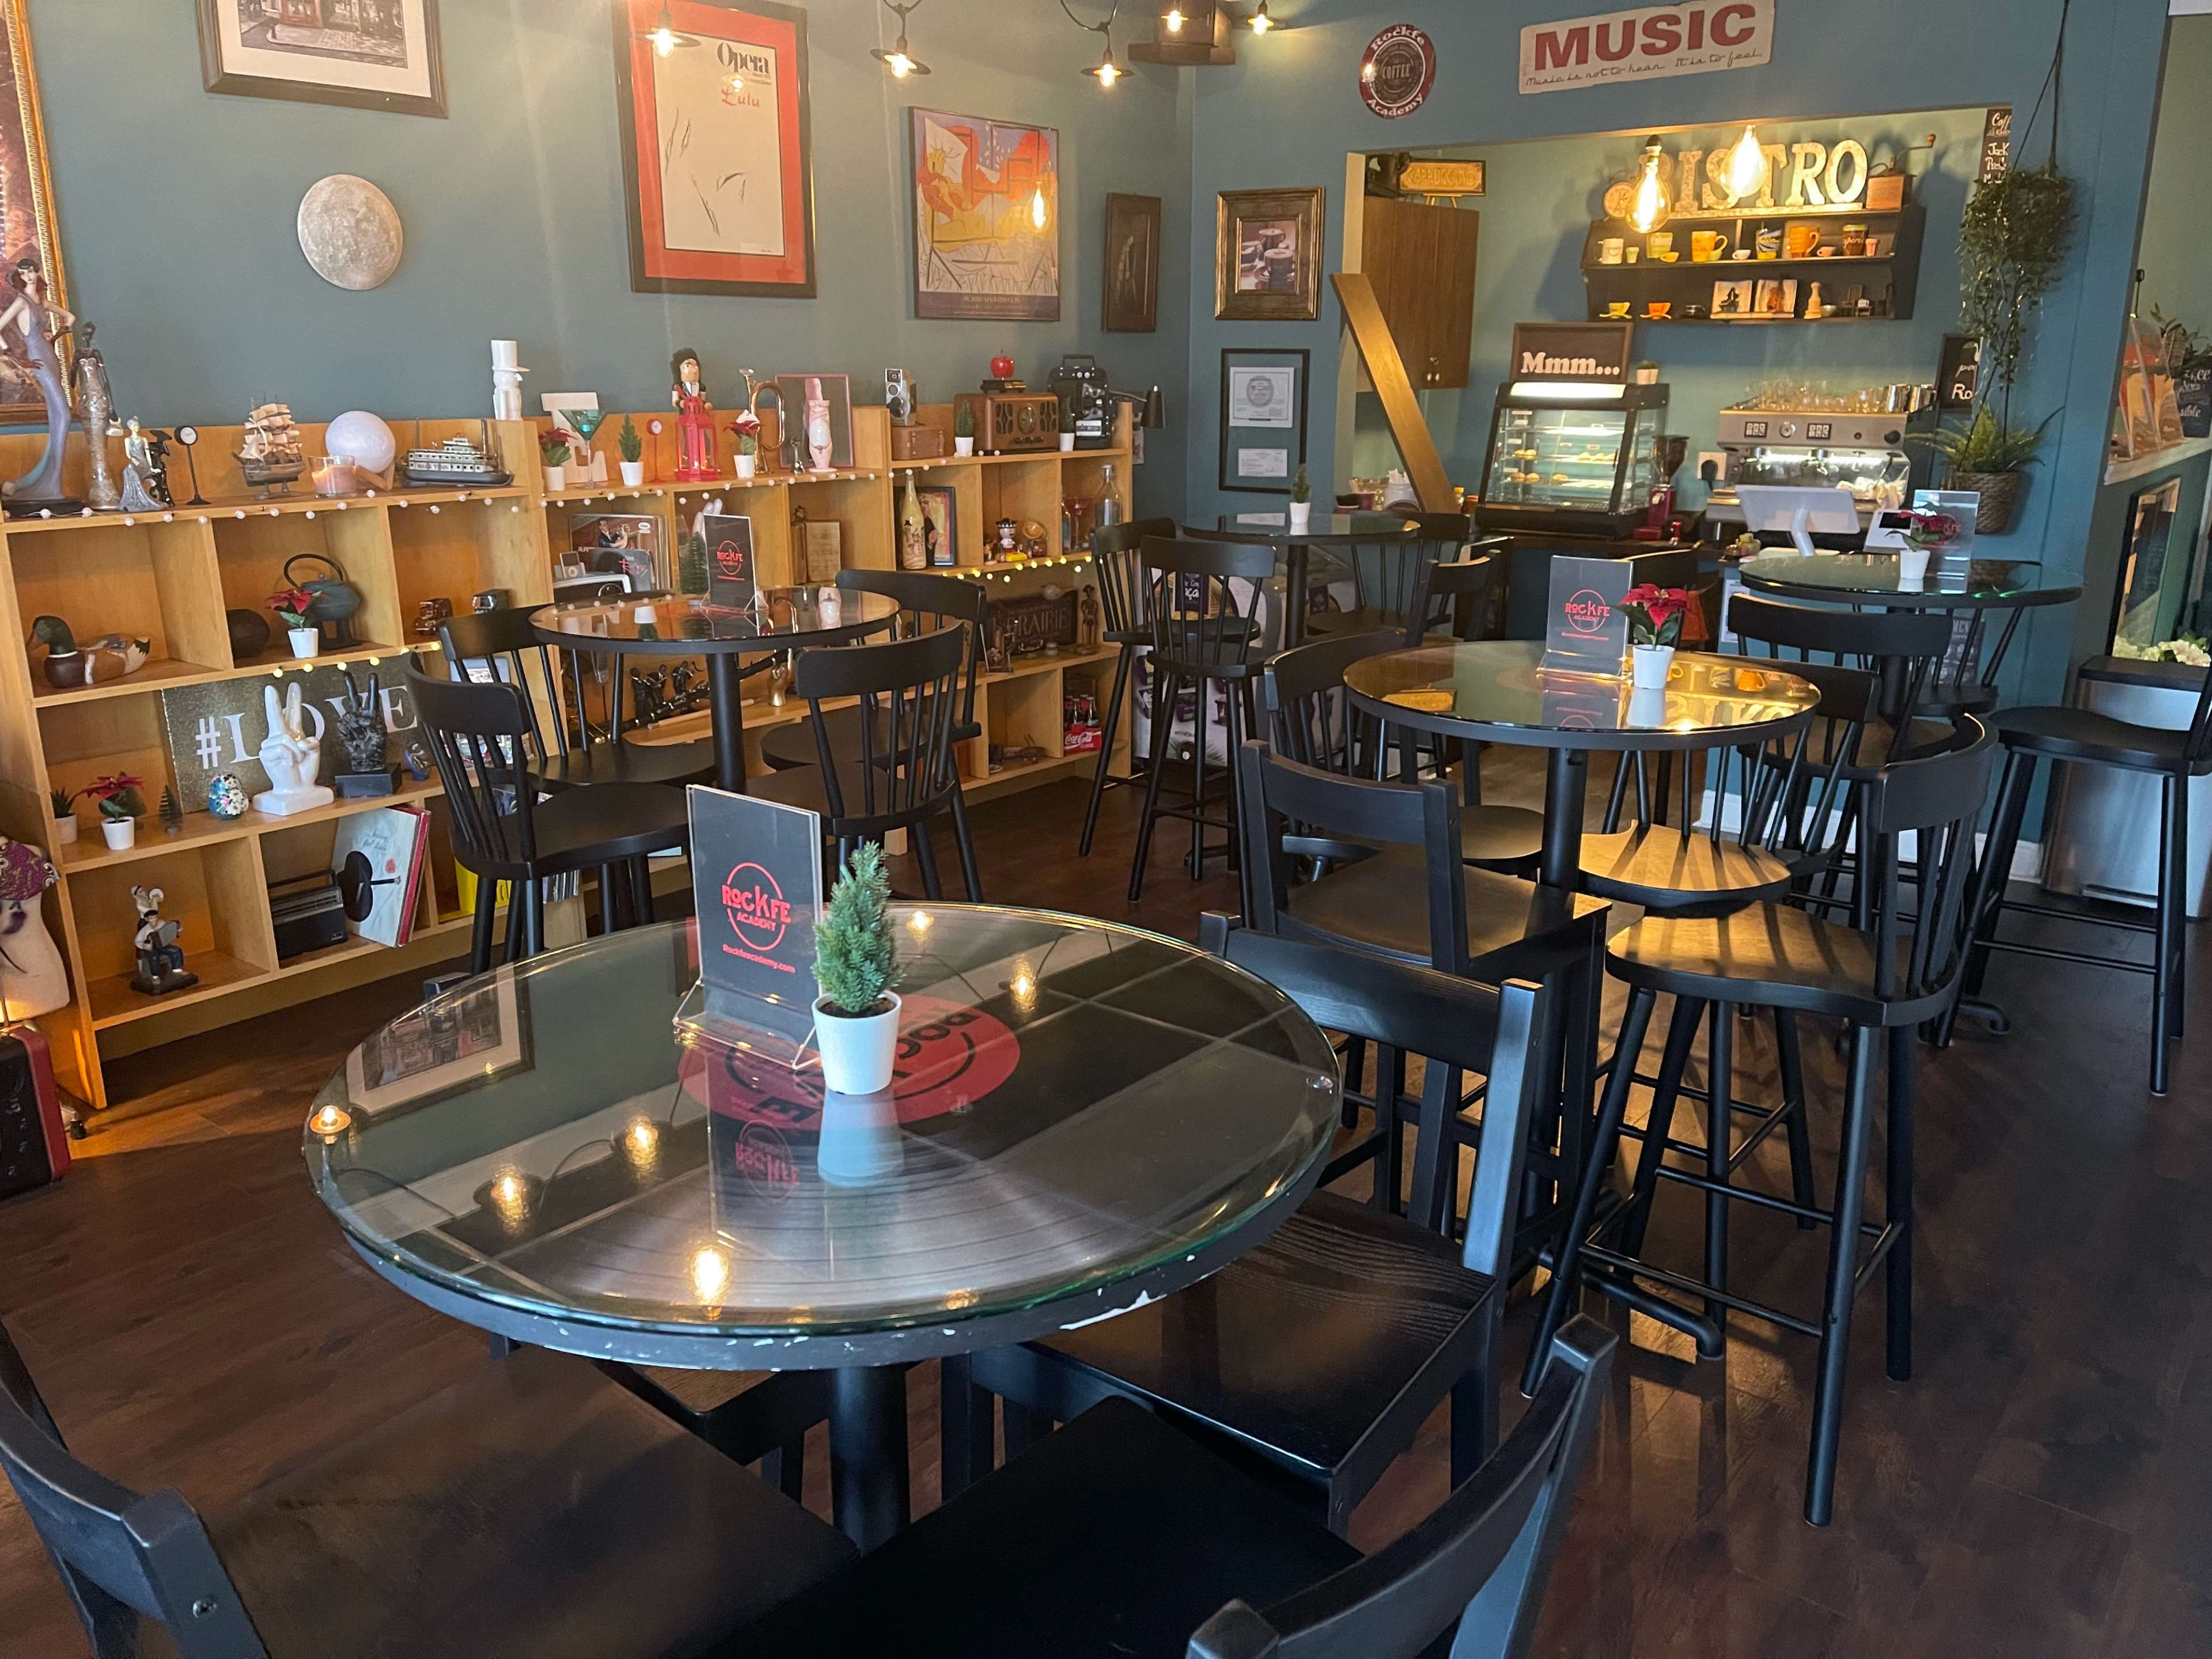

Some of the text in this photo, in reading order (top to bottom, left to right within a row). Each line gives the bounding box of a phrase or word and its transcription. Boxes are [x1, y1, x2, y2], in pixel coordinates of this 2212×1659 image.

[1370, 26, 1425, 51] Rockfe
[1535, 3, 1756, 71] MUSIC
[717, 41, 770, 74] Opera
[1382, 63, 1411, 79] COFFEE
[1526, 75, 1565, 86] Music
[1566, 73, 1583, 81] is
[1586, 67, 1608, 79] not
[1609, 66, 1626, 75] to
[1675, 58, 1689, 67] It
[1689, 56, 1706, 65] is
[1709, 54, 1726, 63] to
[721, 84, 760, 108] Lulu
[1368, 93, 1423, 116] Academy
[1521, 351, 1620, 375] Mmm...
[1565, 600, 1610, 617] ROCKFE
[721, 884, 792, 924] ROCKFE
